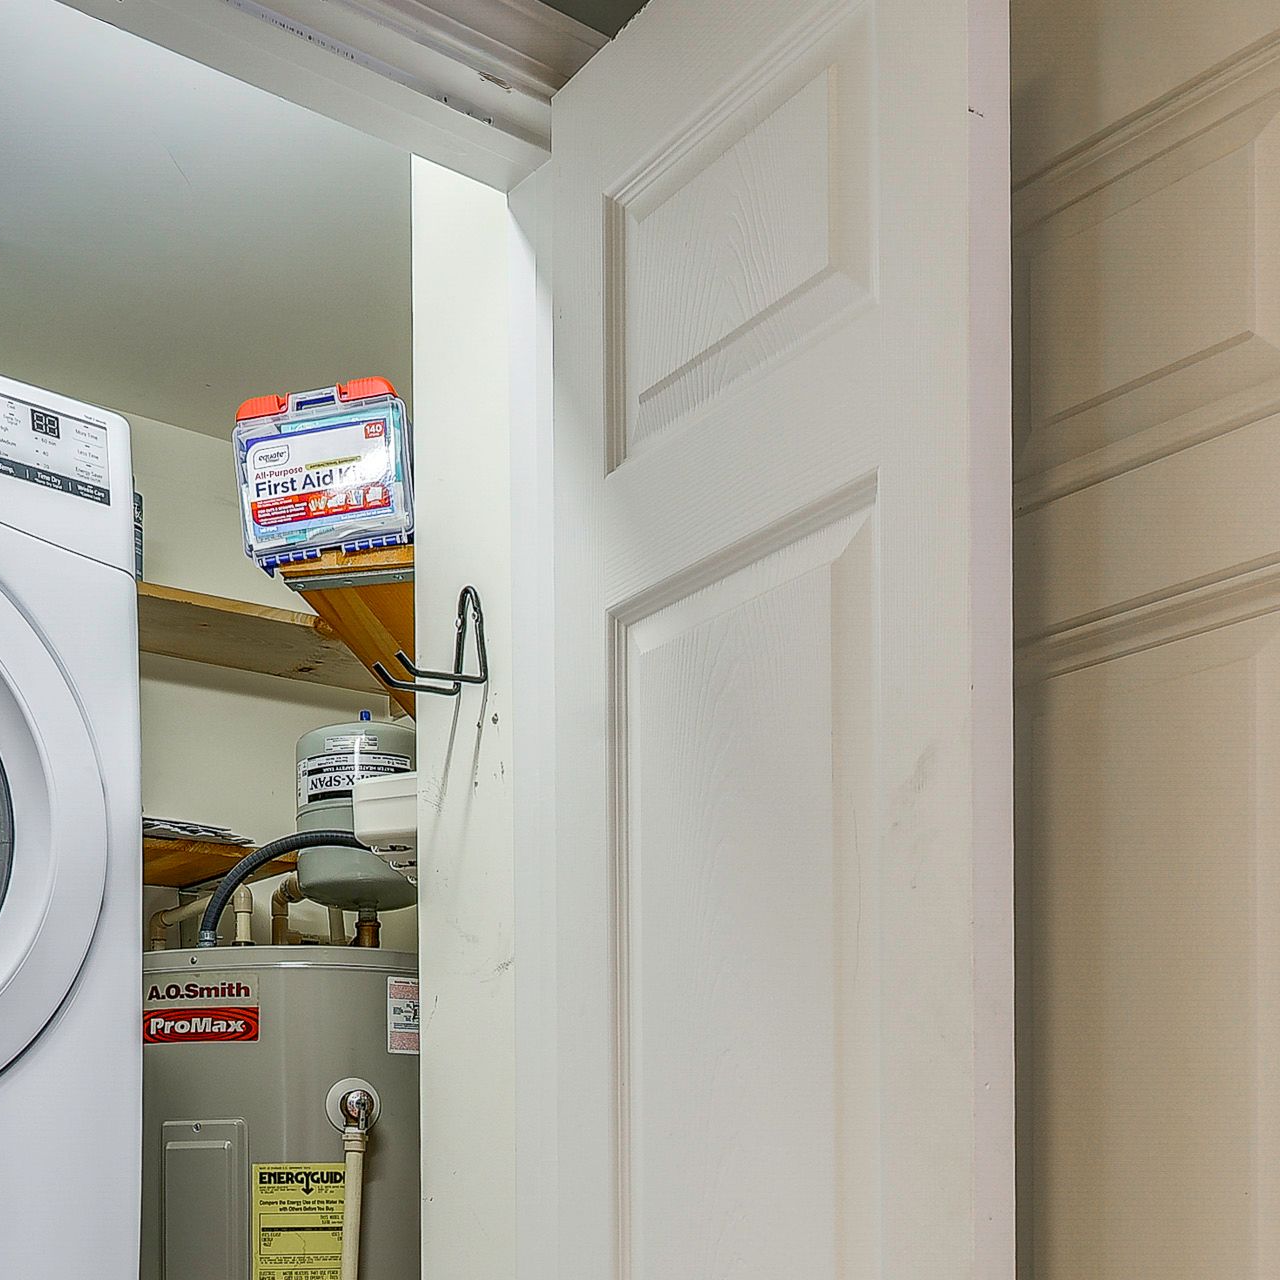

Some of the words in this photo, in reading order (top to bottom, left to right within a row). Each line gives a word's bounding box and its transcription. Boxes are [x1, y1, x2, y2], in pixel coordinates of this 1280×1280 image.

[365, 423, 382, 434] 140
[258, 451, 285, 463] equate
[36, 472, 50, 481] Time
[50, 475, 62, 486] Dry
[255, 466, 303, 481] All-Purpose
[255, 477, 297, 498] First
[301, 468, 334, 490] Aid
[147, 982, 250, 1001] A.O.Smith
[150, 1017, 245, 1035] ProMax
